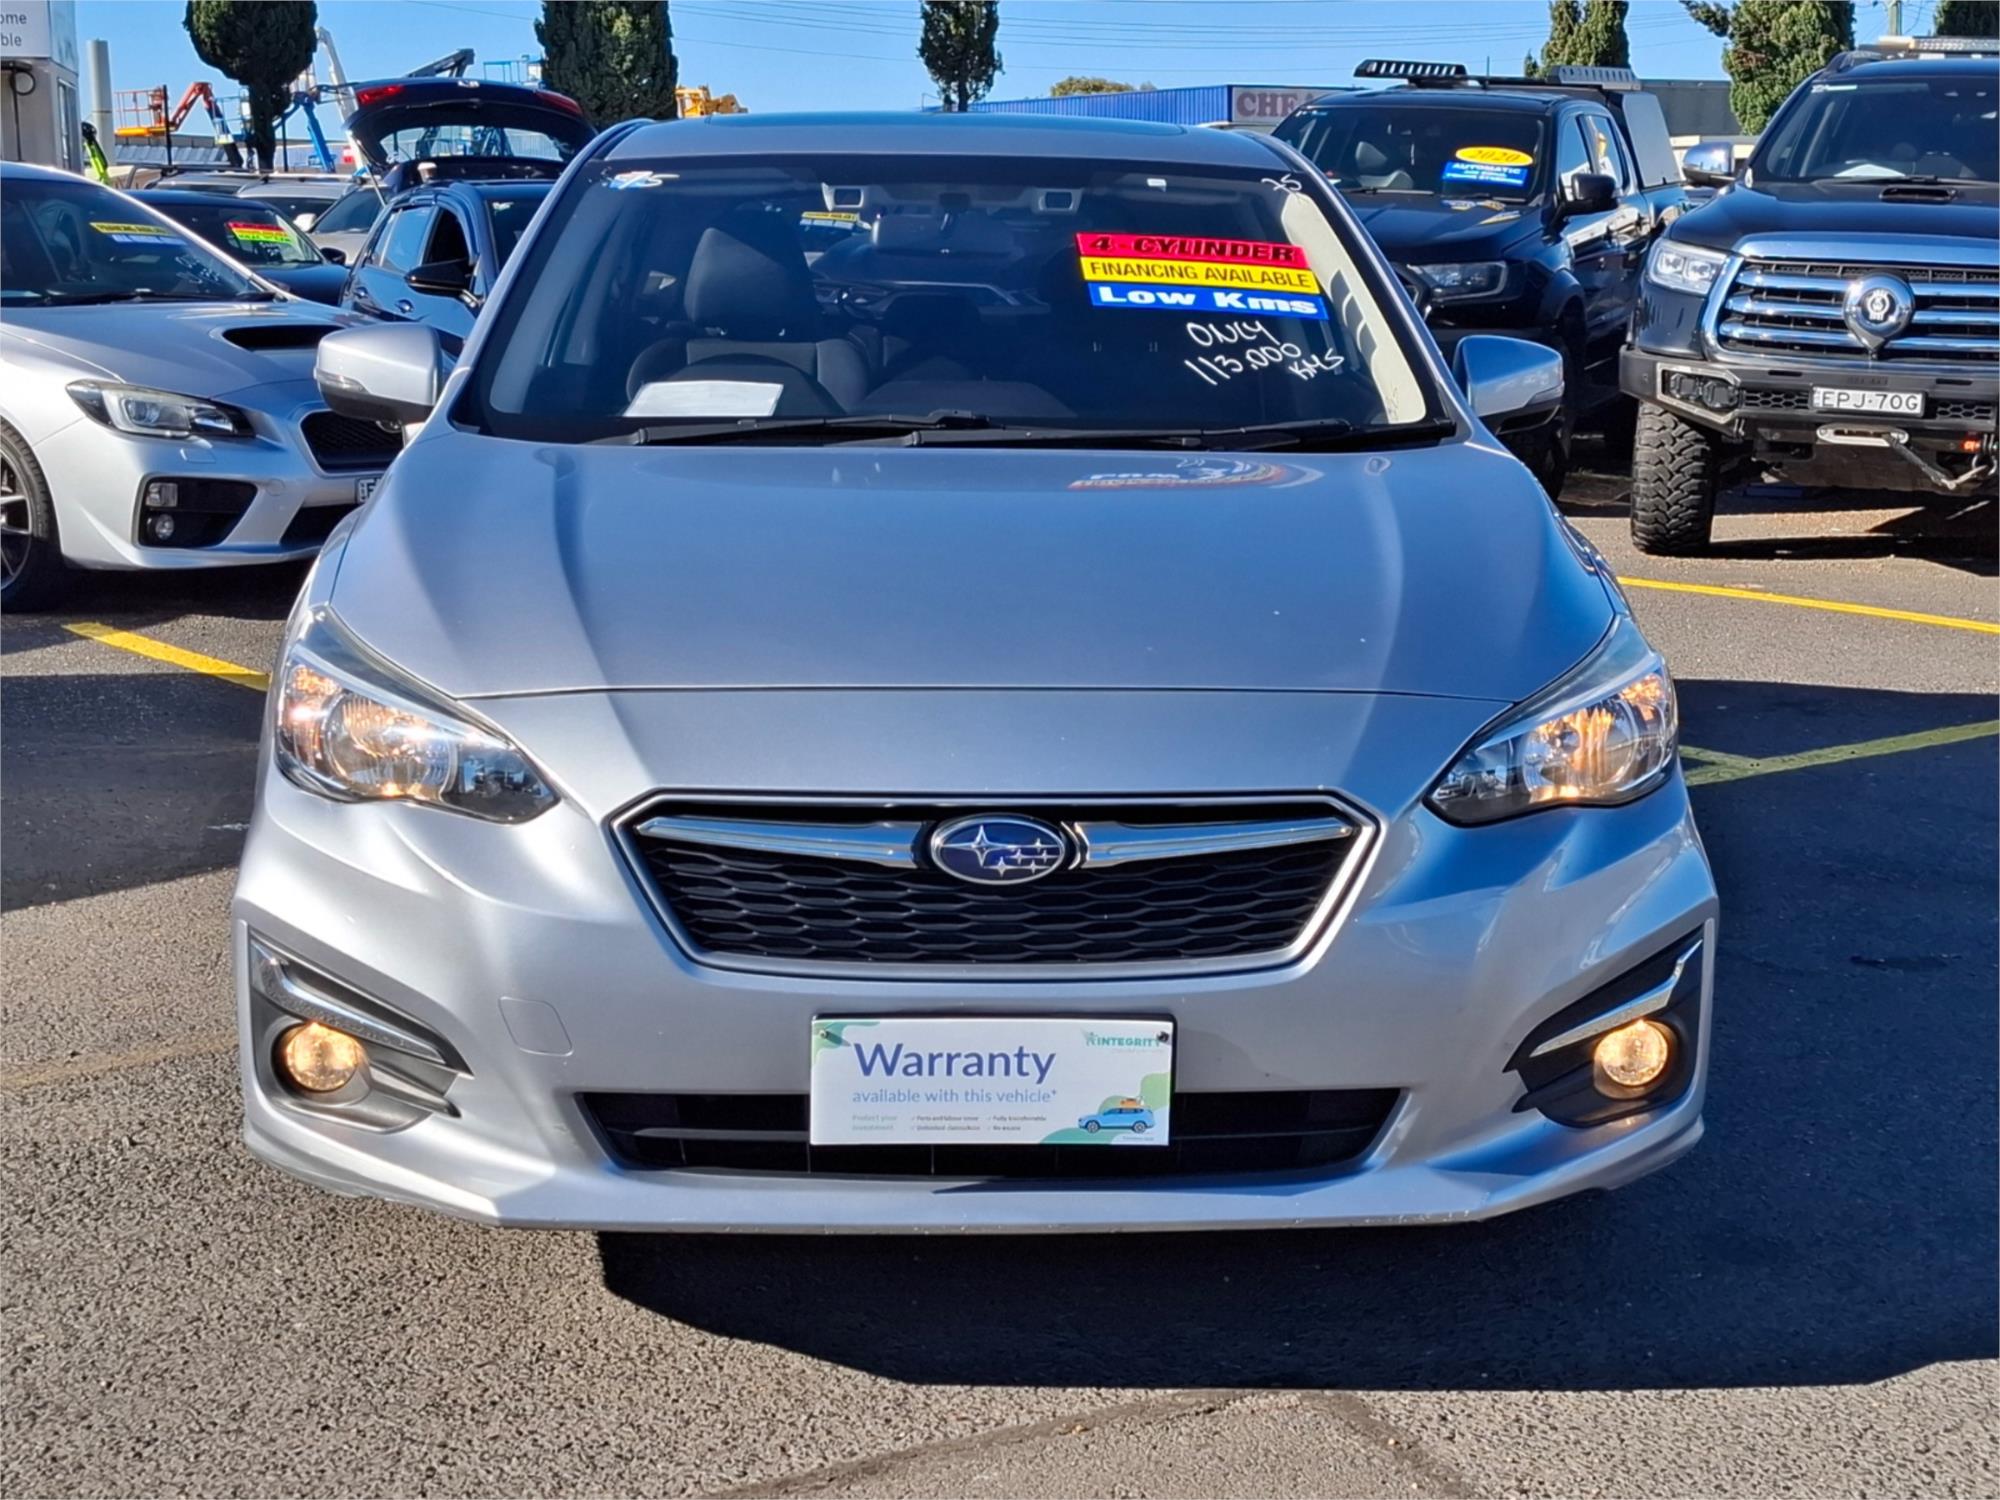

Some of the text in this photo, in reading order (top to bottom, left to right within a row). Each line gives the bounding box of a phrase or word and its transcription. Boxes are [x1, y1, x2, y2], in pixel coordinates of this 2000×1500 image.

[0, 32, 22, 47] ble
[1467, 149, 1521, 163] 2020
[1452, 163, 1522, 175] AUTOMATIC
[1134, 238, 1295, 262] CYLINDER
[1091, 261, 1313, 288] FINANCING AVAILABLE
[1098, 286, 1318, 314] Low Kms
[1186, 320, 1281, 346] ONLY
[853, 1043, 1056, 1085] Warranty
[852, 1088, 920, 1103] available
[923, 1088, 959, 1103] with
[964, 1088, 992, 1103] this
